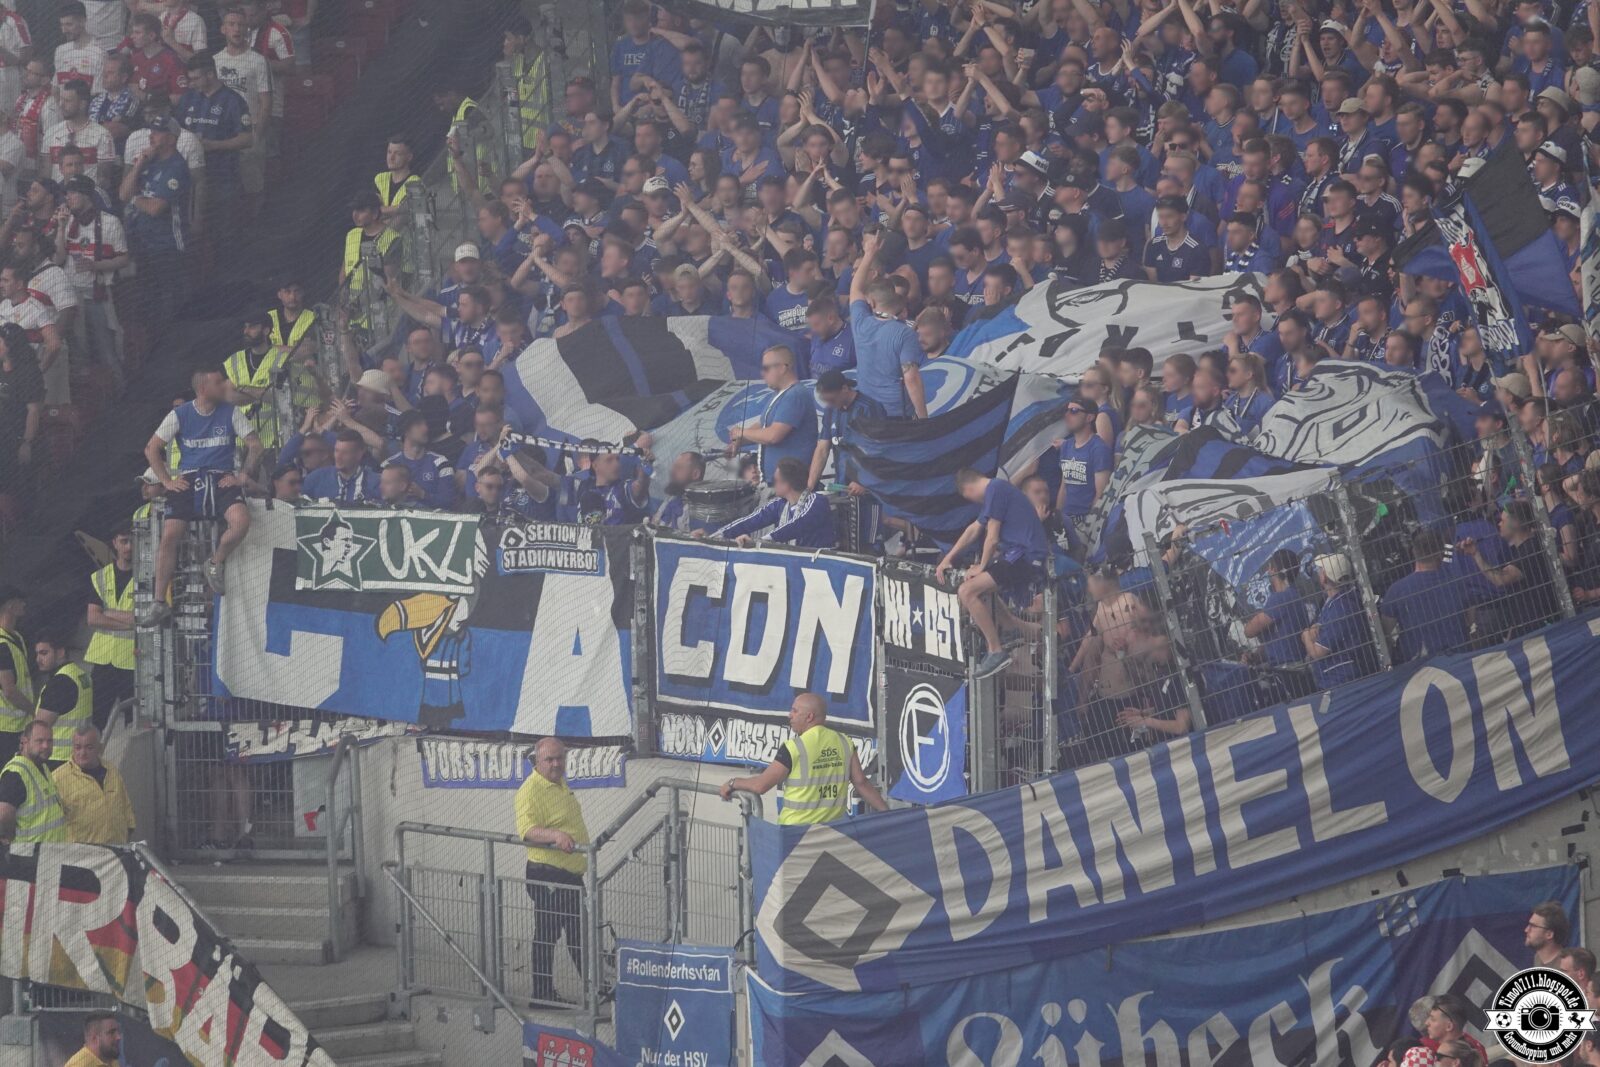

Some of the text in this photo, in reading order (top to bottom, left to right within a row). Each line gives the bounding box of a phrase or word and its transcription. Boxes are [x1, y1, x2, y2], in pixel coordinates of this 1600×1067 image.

[527, 523, 577, 544] SEKTION
[503, 549, 599, 571] STADIONVERBOT
[883, 575, 965, 663] HH OST
[1400, 636, 1571, 803] ON
[422, 740, 525, 781] VORSTADT
[821, 748, 838, 757] SDS
[819, 784, 838, 798] 1219
[626, 957, 721, 982] #Rollenderhsvfan
[640, 1047, 708, 1067] Nur der HSV
